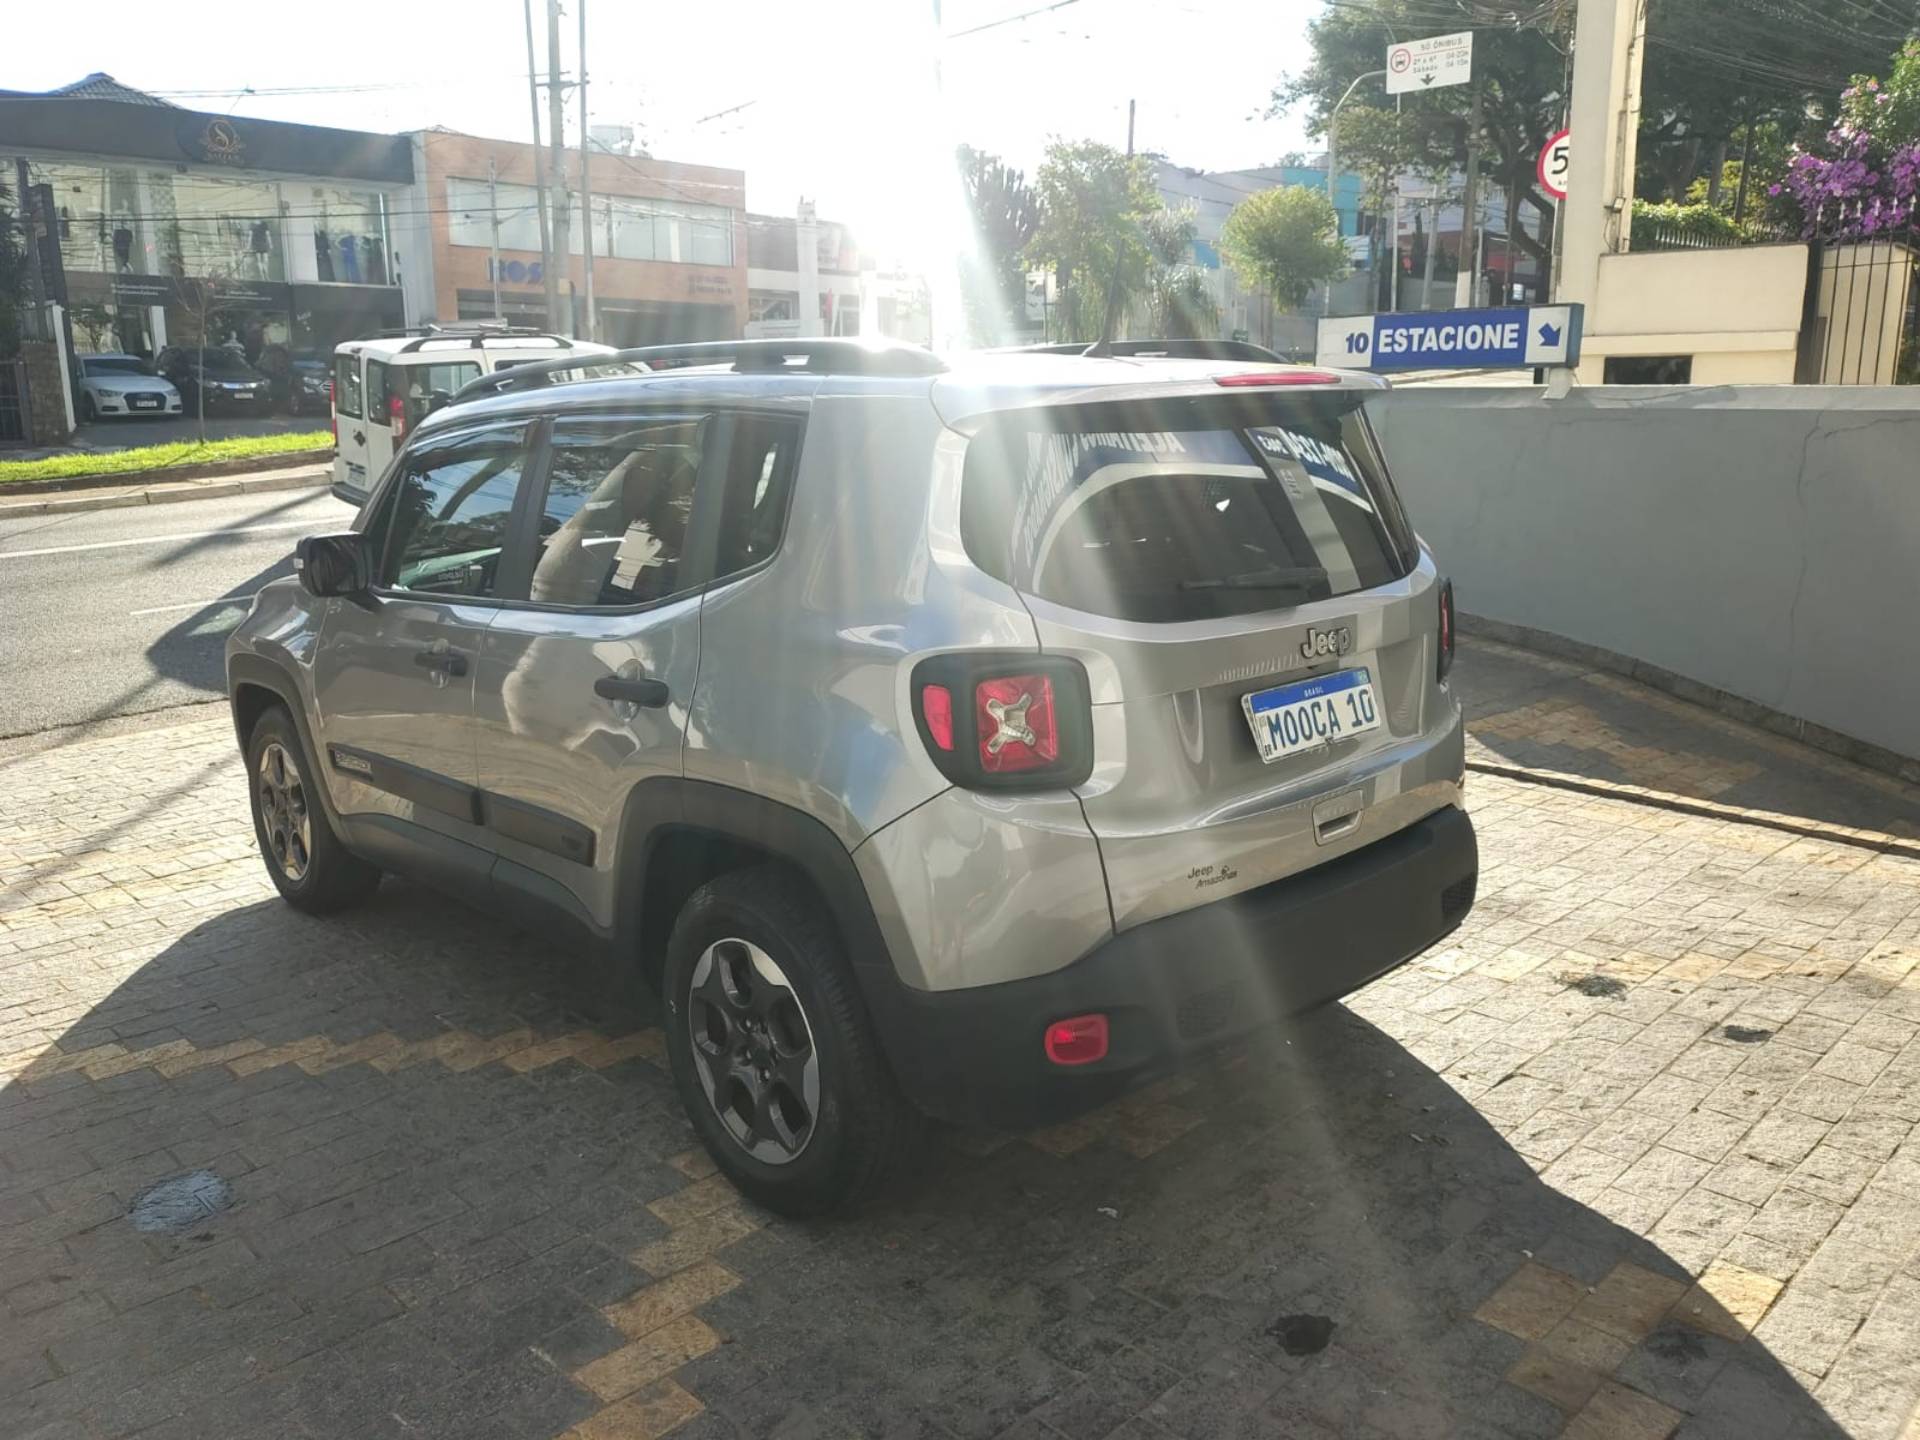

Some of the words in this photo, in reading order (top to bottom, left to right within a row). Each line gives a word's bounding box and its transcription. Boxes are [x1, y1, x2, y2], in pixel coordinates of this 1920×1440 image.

[1345, 332, 1370, 354] 10
[1378, 323, 1520, 354] ESTACIONE
[1301, 628, 1350, 658] Jeep
[1267, 699, 1341, 750] MOOCA
[1346, 688, 1375, 728] 10
[1187, 865, 1214, 879] Jeep
